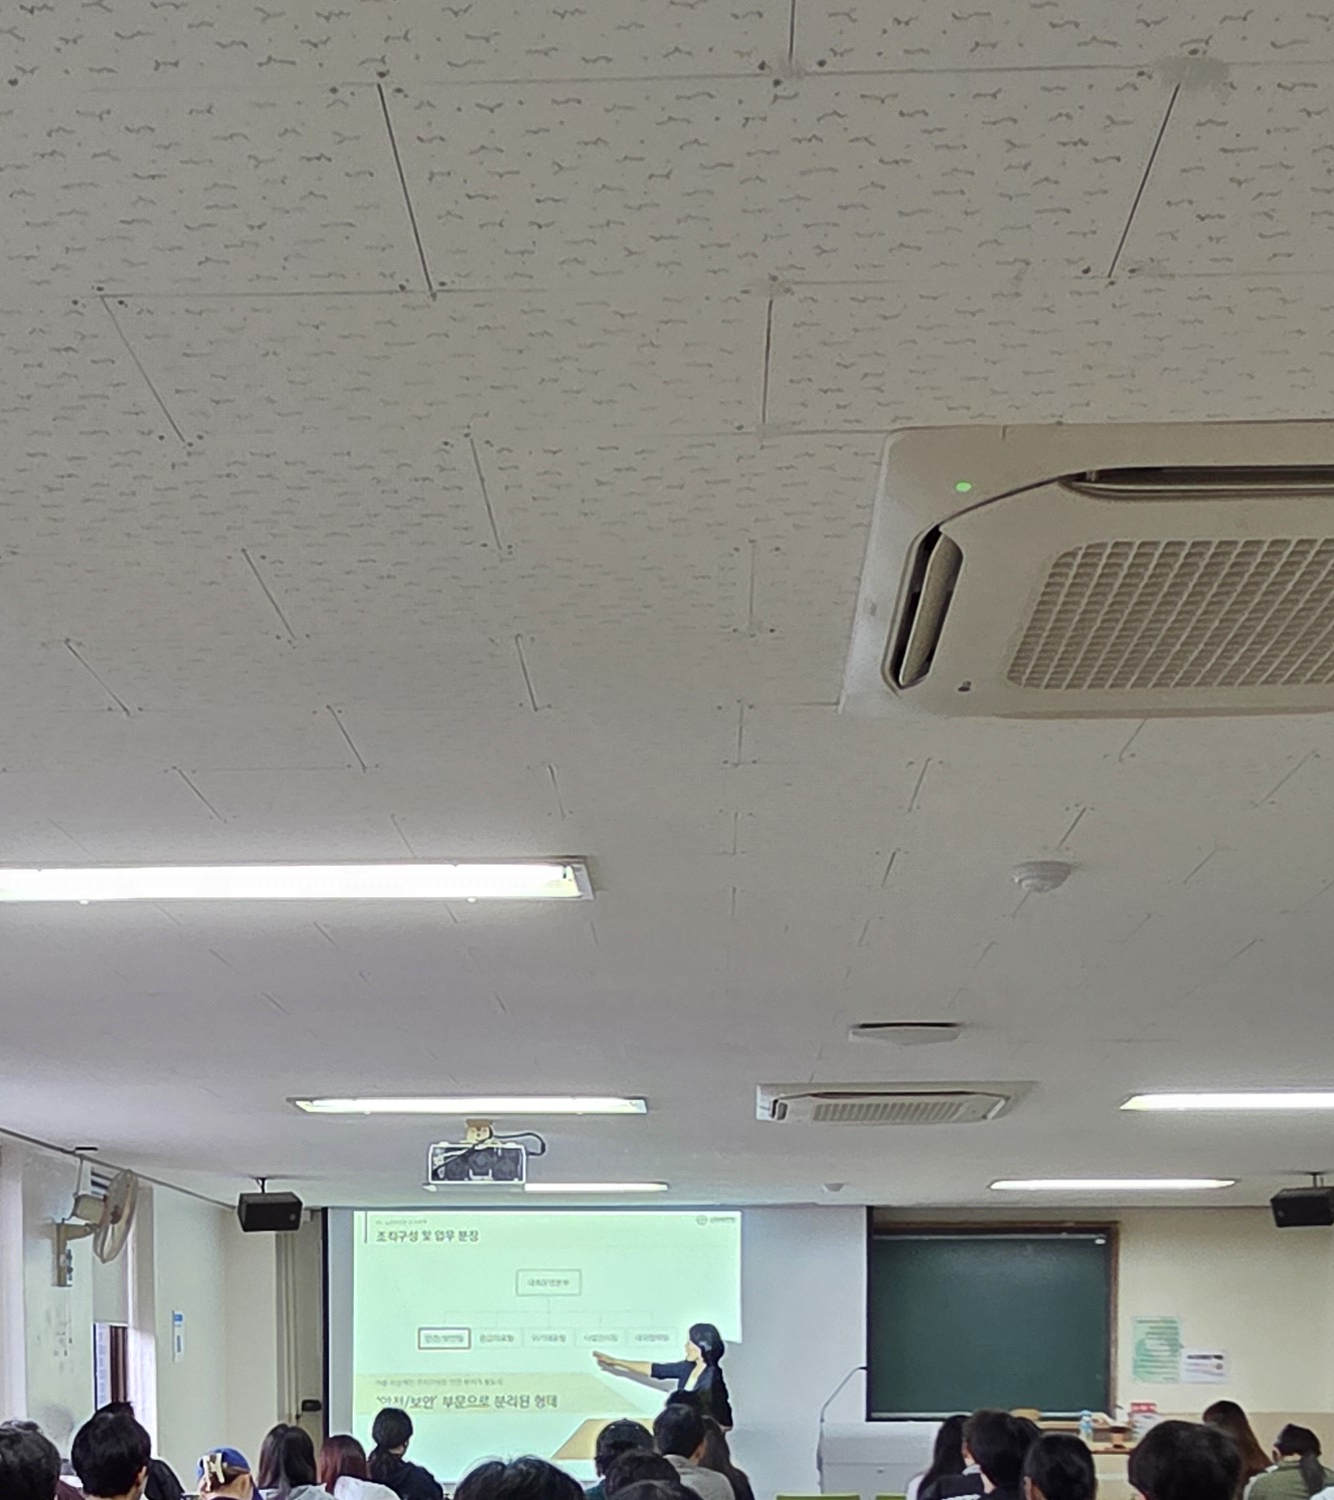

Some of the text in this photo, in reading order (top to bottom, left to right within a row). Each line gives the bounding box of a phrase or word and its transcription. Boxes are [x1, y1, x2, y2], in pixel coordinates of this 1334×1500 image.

[376, 1230, 419, 1243] 조직구성
[434, 1229, 455, 1243] 업무
[494, 1395, 530, 1409] 분리된
[534, 1395, 559, 1409] 형태
